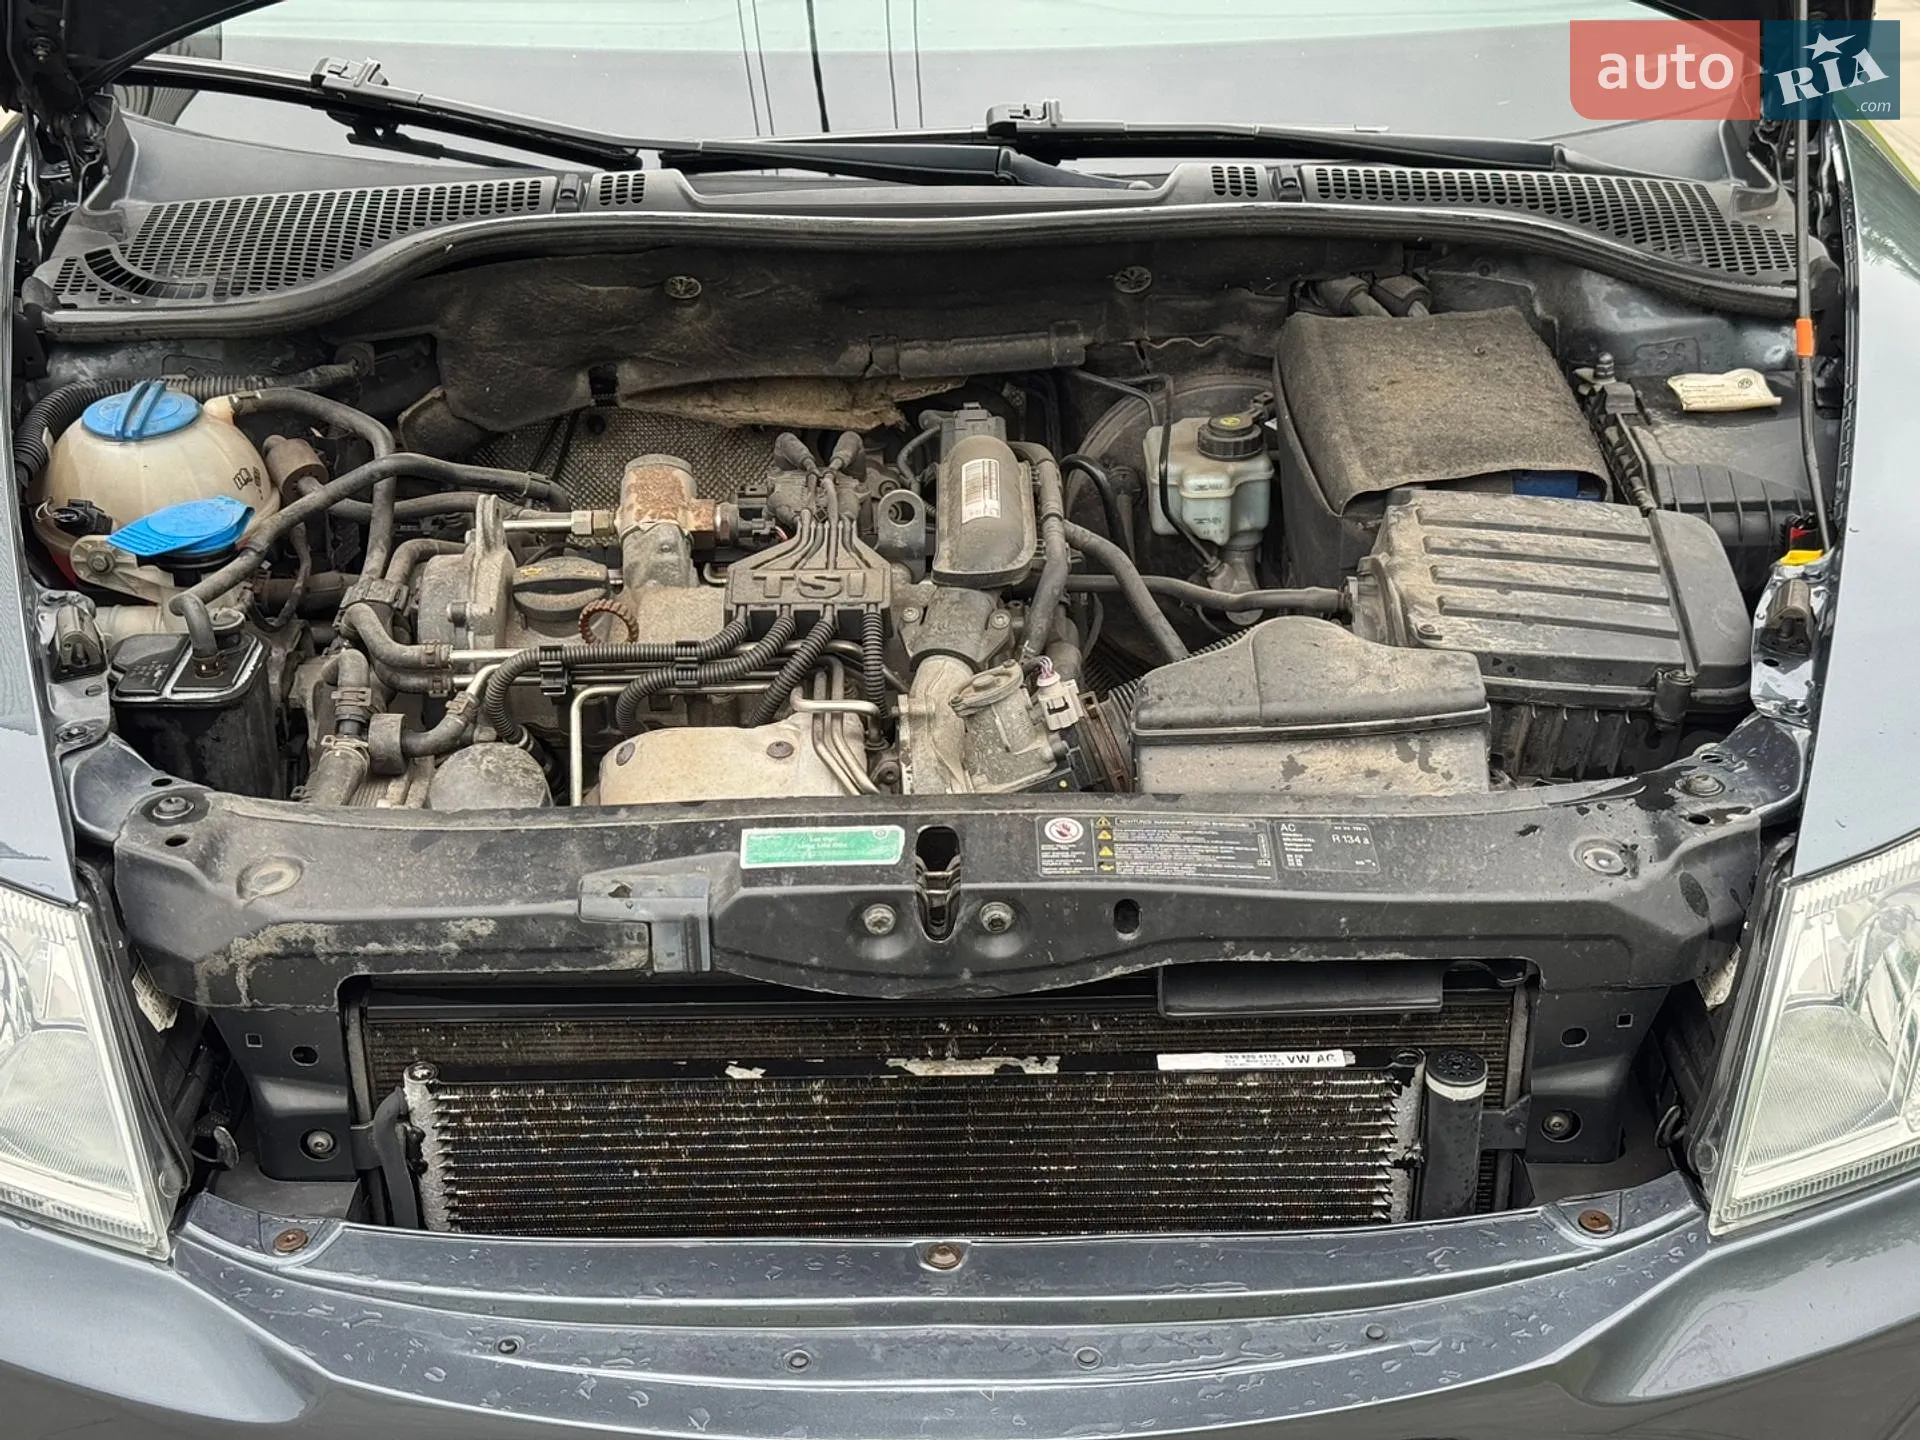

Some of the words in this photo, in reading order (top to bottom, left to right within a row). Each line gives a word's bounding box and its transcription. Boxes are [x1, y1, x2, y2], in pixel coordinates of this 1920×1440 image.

[752, 573, 866, 599] TSI
[1280, 823, 1297, 833] AC
[1286, 1053, 1311, 1064] VW
